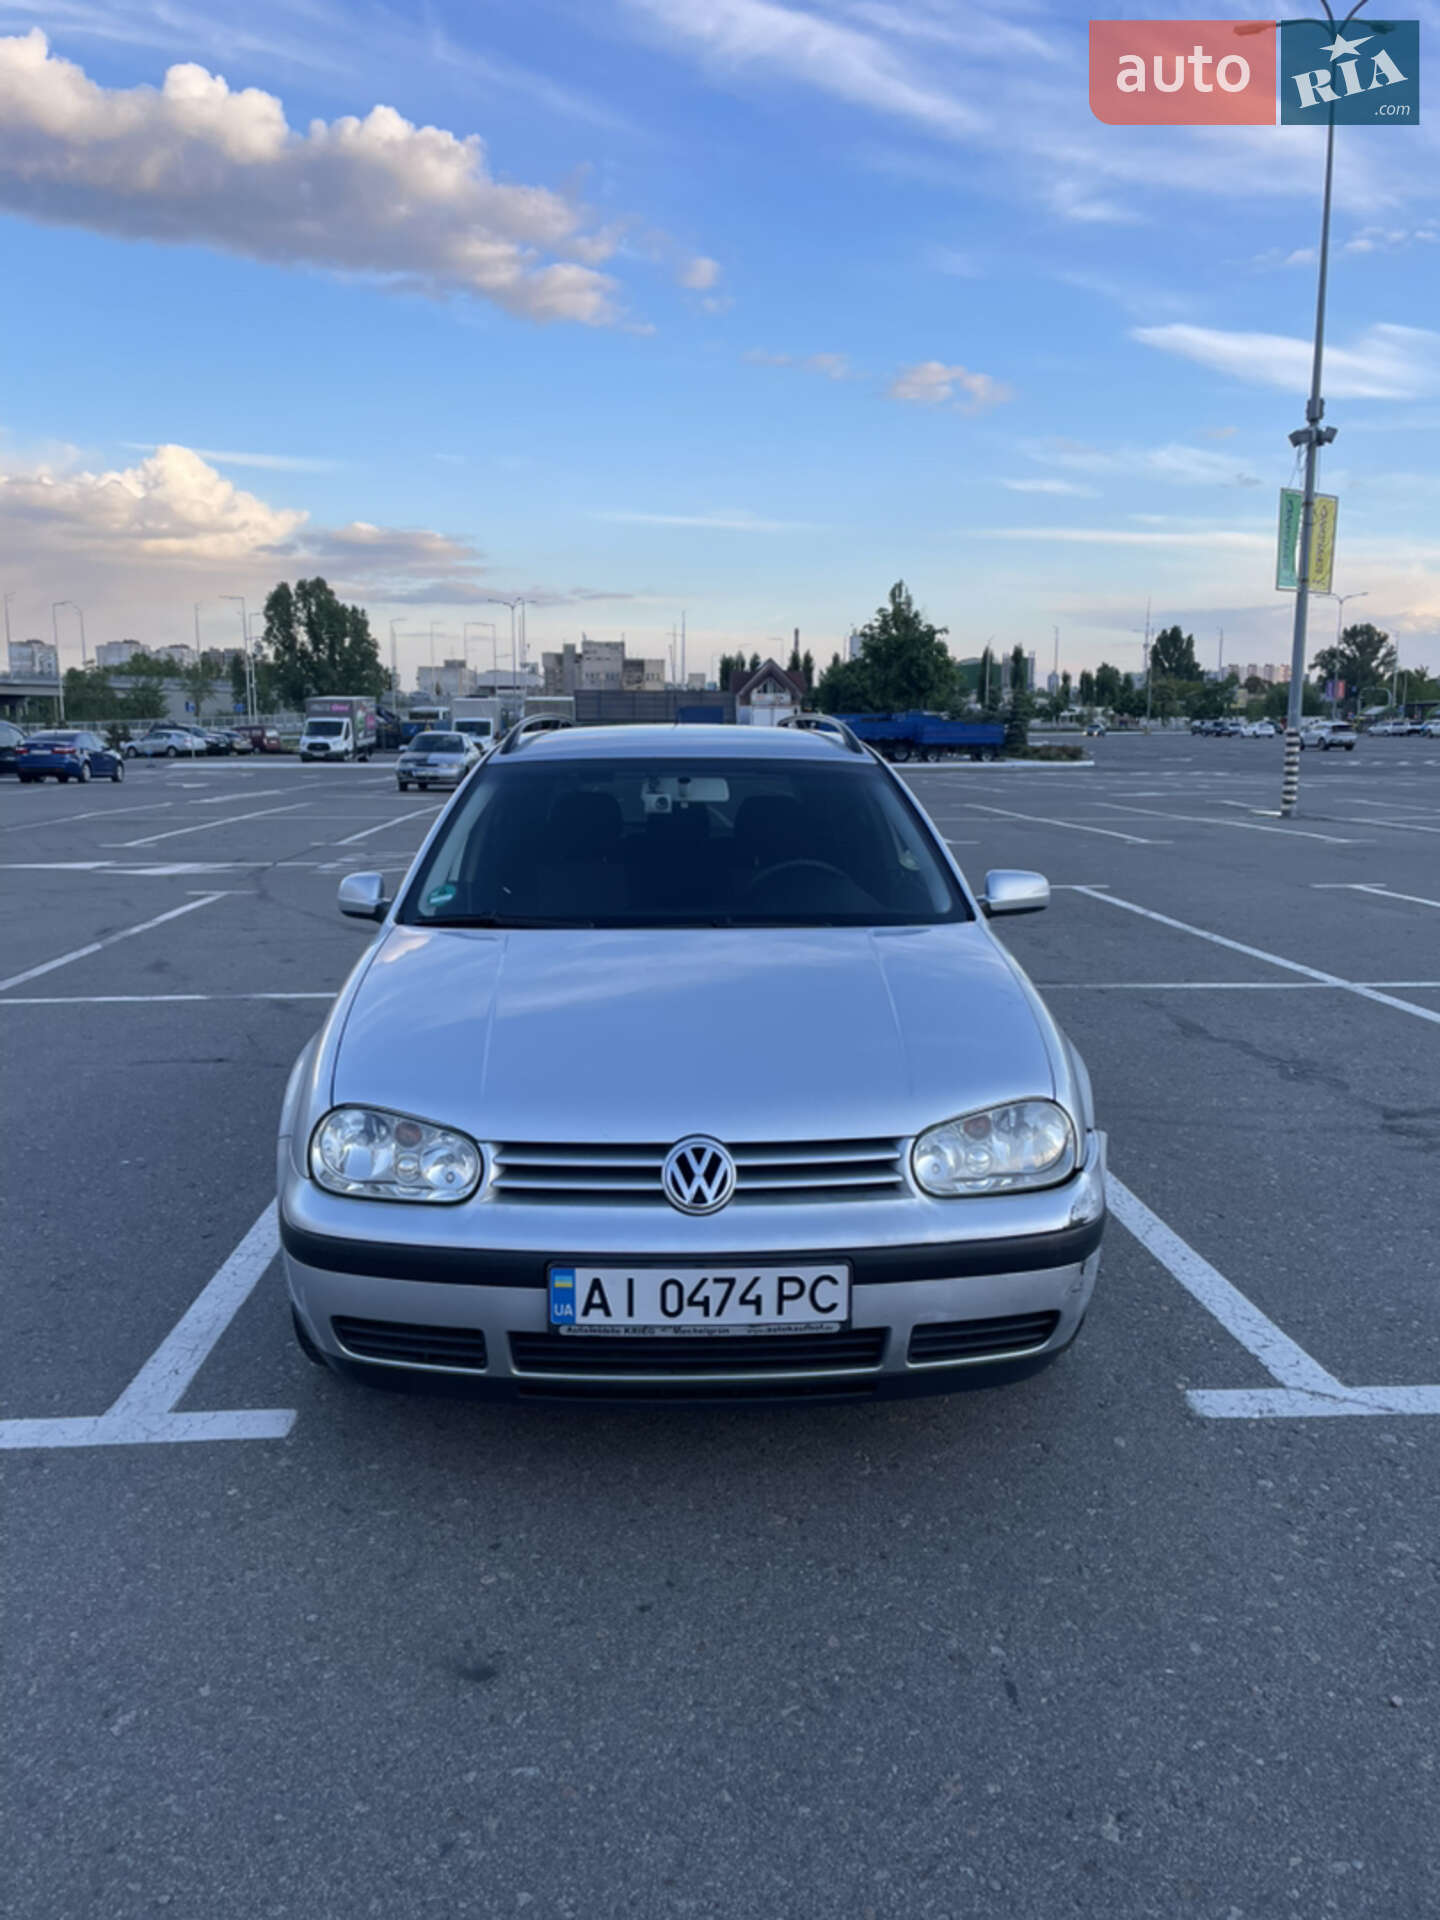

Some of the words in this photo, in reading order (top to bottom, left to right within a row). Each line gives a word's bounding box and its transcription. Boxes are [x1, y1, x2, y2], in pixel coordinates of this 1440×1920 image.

[668, 1143, 730, 1207] VW
[554, 1303, 573, 1317] UA
[659, 1276, 763, 1318] 0474
[777, 1274, 840, 1316] PC
